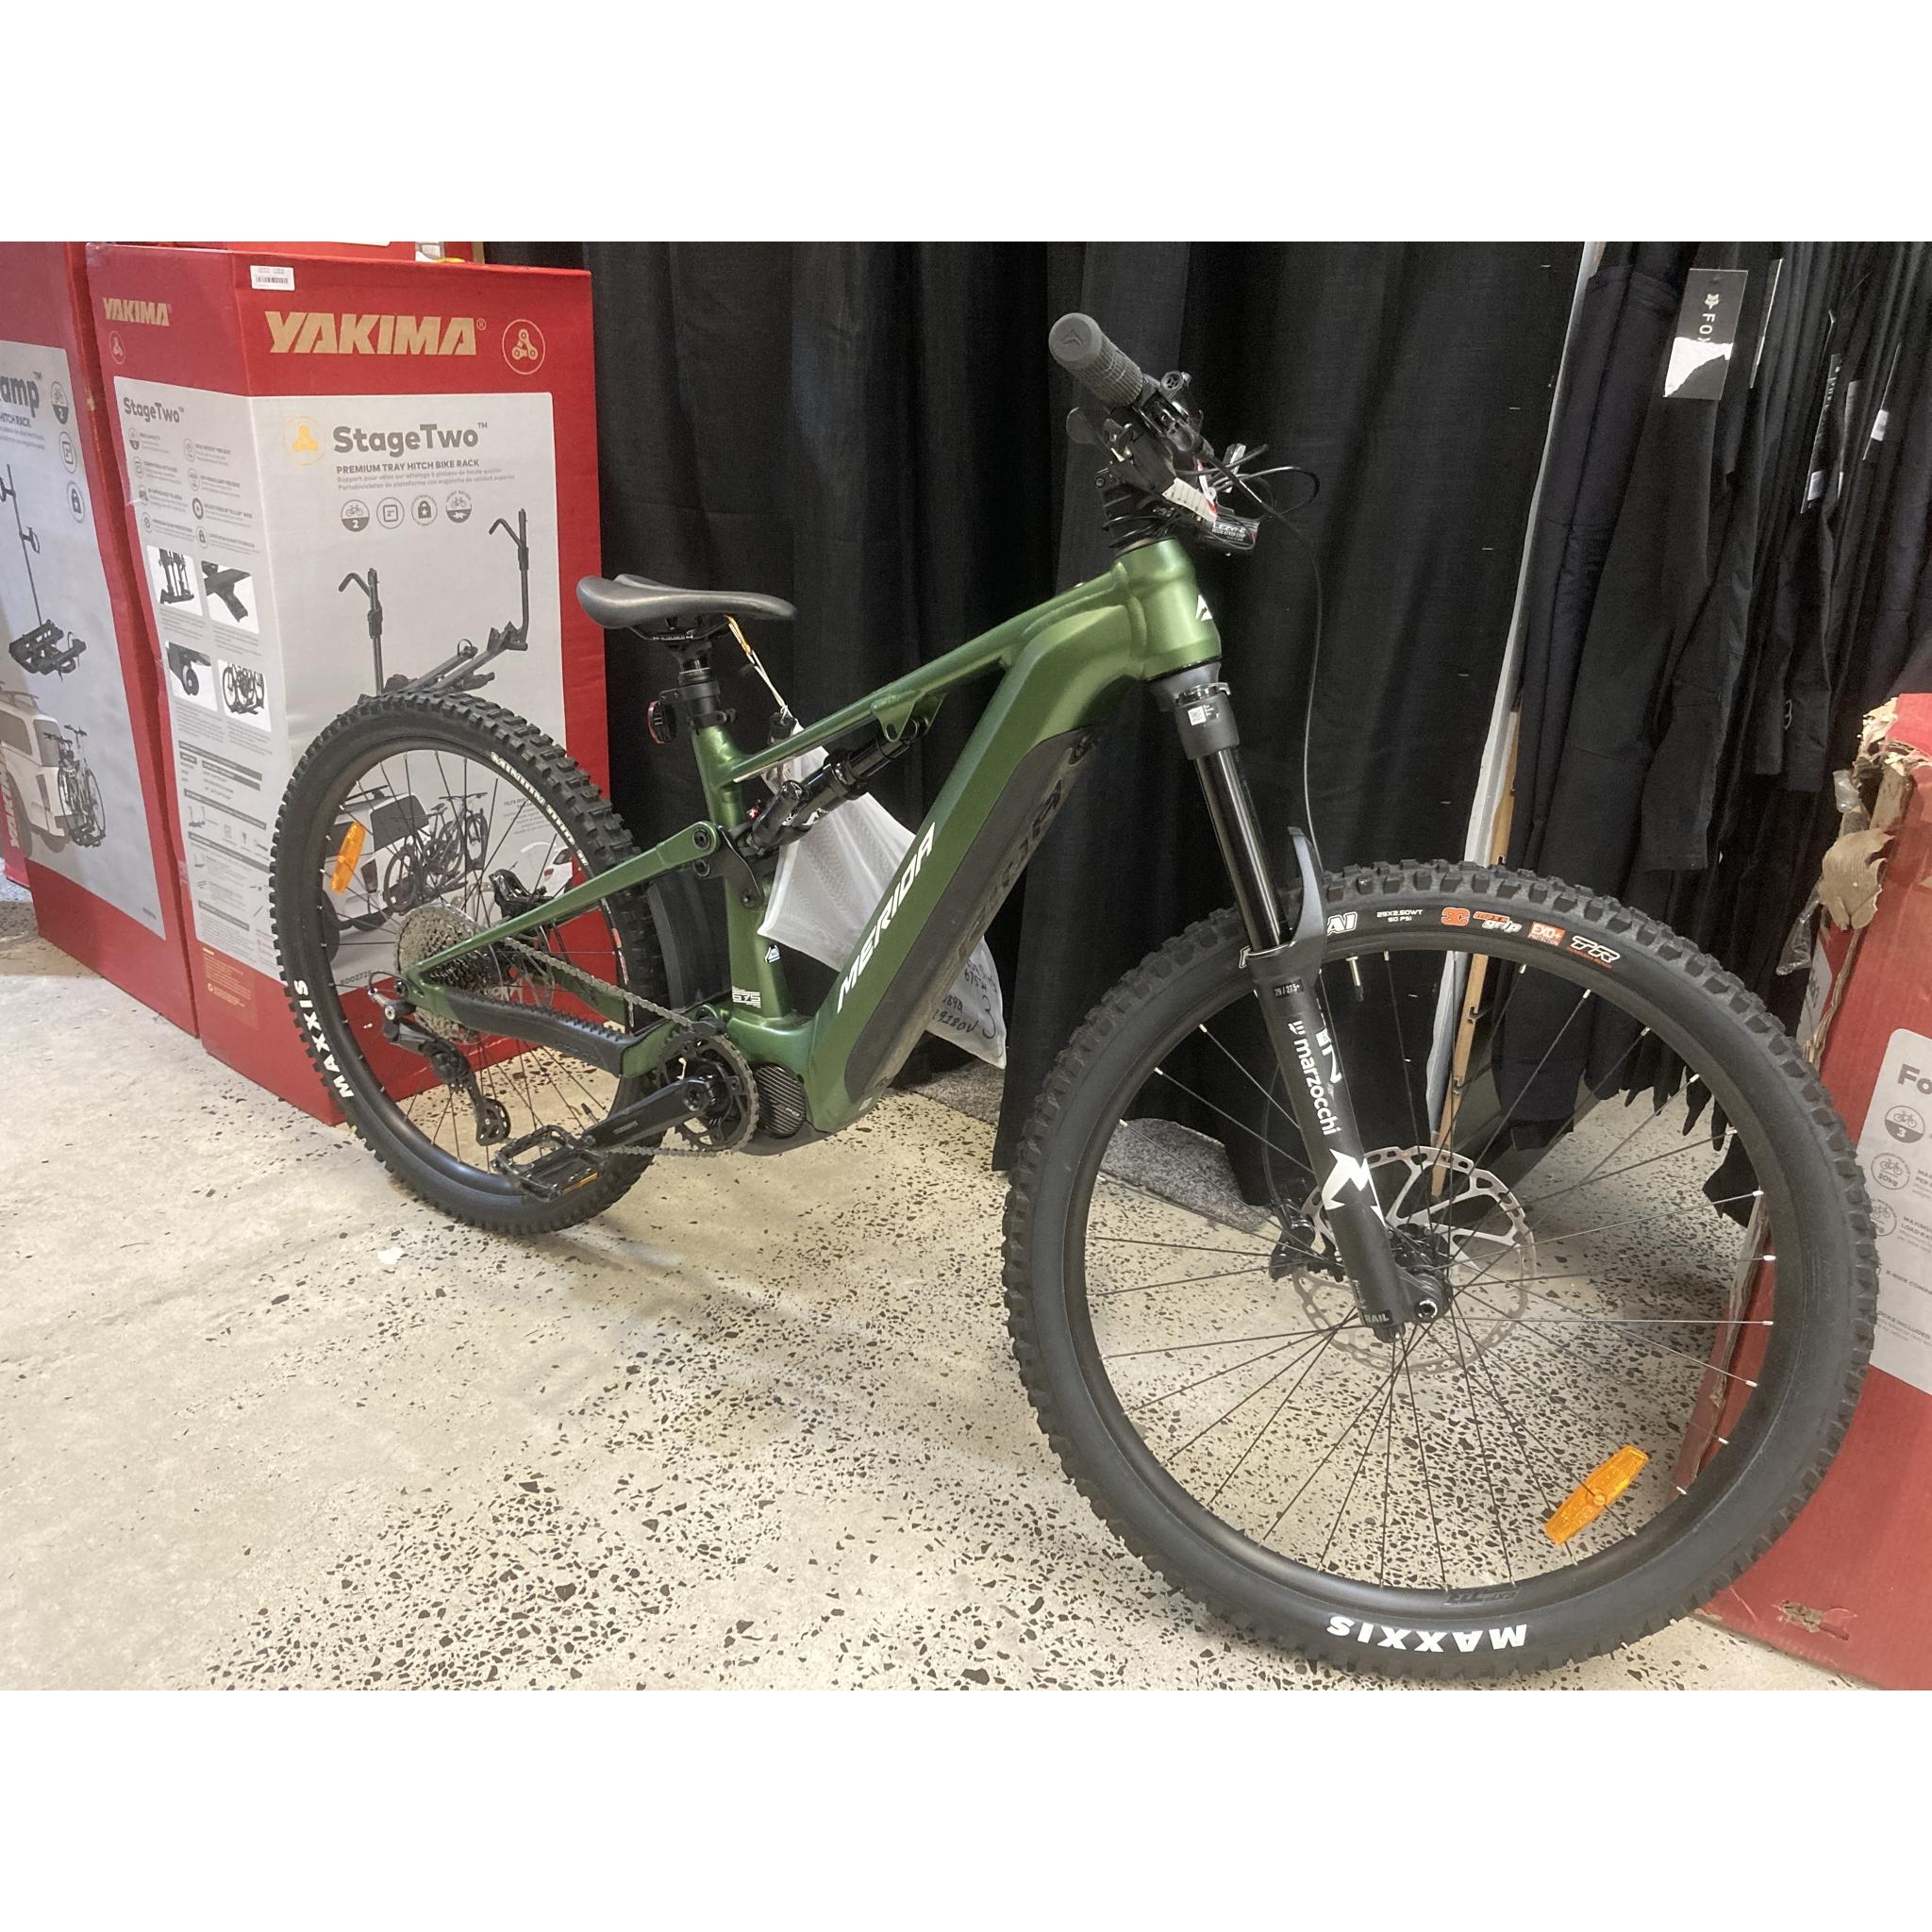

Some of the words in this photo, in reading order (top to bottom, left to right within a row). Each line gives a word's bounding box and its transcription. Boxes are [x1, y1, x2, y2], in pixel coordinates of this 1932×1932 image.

[103, 297, 172, 325] YAKIMA
[337, 464, 380, 474] PREMIUM
[382, 463, 405, 472] TRAY
[407, 461, 434, 470] HITCH
[436, 460, 455, 469] BIKE
[457, 458, 479, 468] RACK
[352, 520, 359, 529] 2
[837, 822, 935, 1014] MERIDA
[1482, 920, 1522, 933] grip
[1571, 935, 1621, 963] TR
[293, 979, 355, 1098] MAXXIS
[1294, 1039, 1342, 1135] marzocchi
[1897, 1063, 1932, 1095] Fo
[1896, 1126, 1907, 1139] 3
[1896, 1320, 1932, 1340] INCLUDED
[1326, 1615, 1527, 1653] MAXXIS
